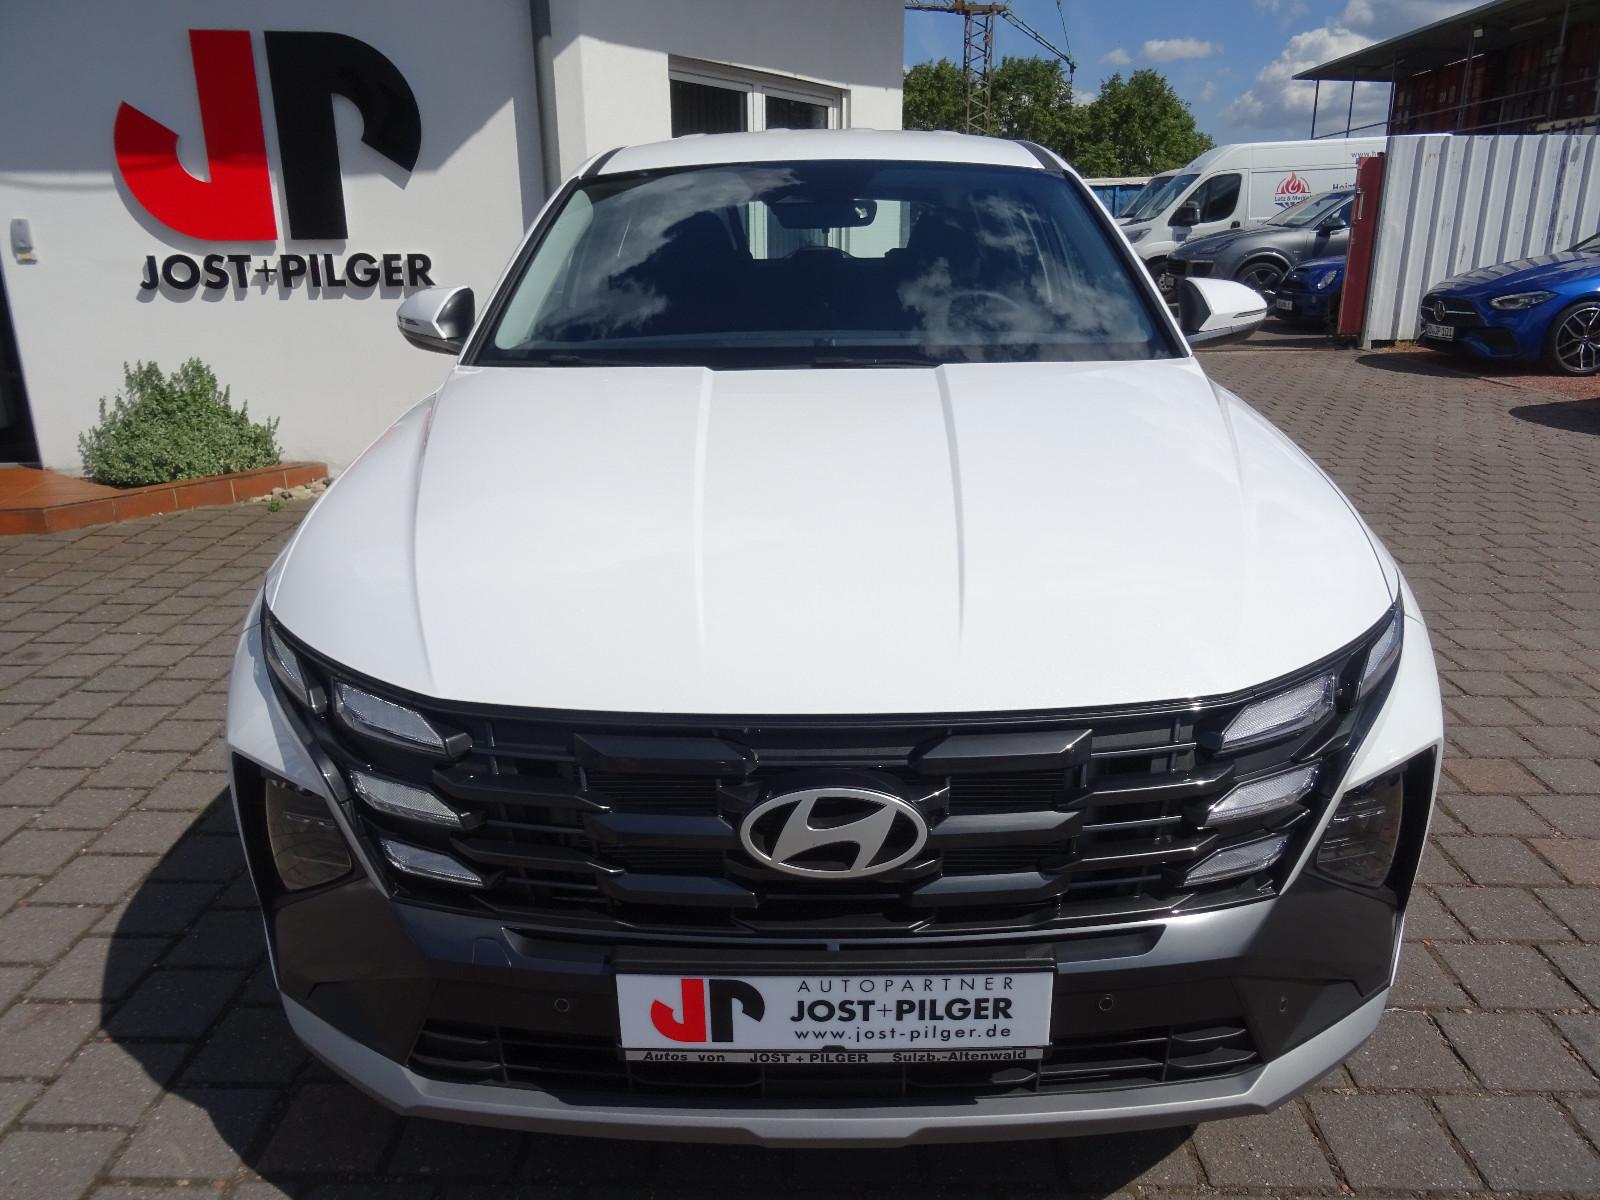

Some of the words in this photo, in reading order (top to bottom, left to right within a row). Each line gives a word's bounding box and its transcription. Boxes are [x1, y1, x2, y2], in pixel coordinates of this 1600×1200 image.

[139, 253, 435, 290] JOST+PILGER
[797, 977, 1014, 993] AUTOPARTNER
[789, 997, 1014, 1022] JOST+PILGER
[794, 1024, 1011, 1042] www.jost-pilger.de
[643, 1052, 688, 1062] Autos
[697, 1053, 725, 1062] von
[750, 1053, 791, 1063] JOST
[809, 1053, 869, 1063] PILGER
[892, 1050, 1027, 1062] Sulzb.-Altenwald
